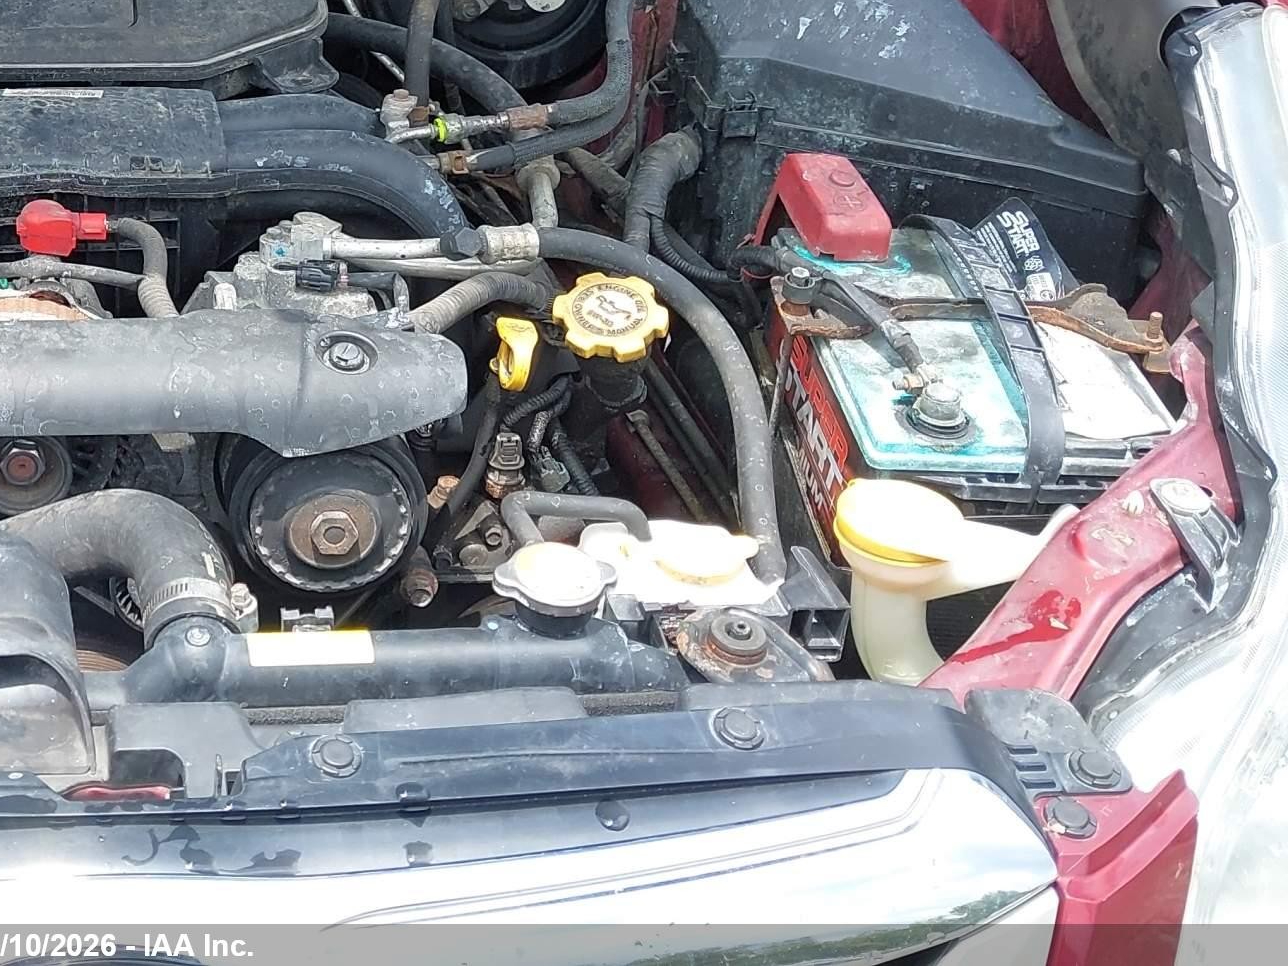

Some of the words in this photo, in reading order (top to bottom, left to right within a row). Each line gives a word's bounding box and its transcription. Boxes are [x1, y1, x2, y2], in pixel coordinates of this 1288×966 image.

[996, 211, 1031, 257] START
[1014, 210, 1041, 252] SUPER
[598, 284, 637, 299] ENGINE
[634, 299, 645, 314] OIL
[606, 317, 643, 336] MANUAL
[785, 356, 844, 491] TART
[791, 334, 848, 473] SUPER
